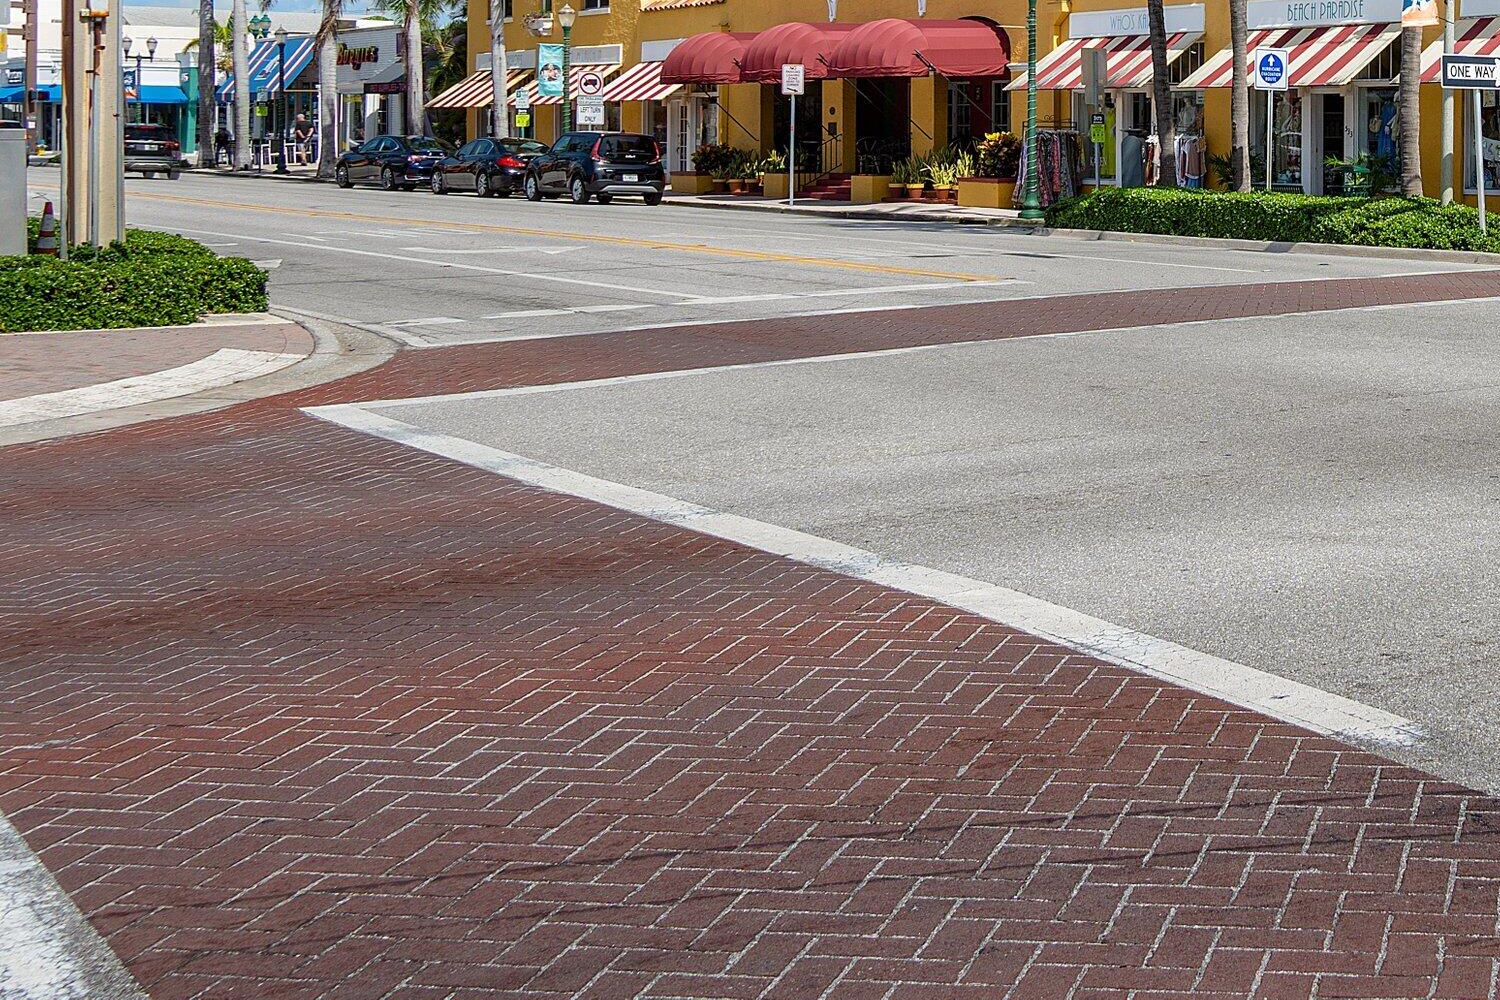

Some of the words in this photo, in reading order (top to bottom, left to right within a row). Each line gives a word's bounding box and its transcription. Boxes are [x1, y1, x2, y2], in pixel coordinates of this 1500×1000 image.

[1287, 2, 1316, 21] BEACH
[1320, 0, 1363, 20] PARADISE
[1110, 14, 1135, 31] WHO'S
[1138, 13, 1149, 30] KA
[1450, 65, 1471, 78] ONE
[1474, 66, 1496, 79] WAY
